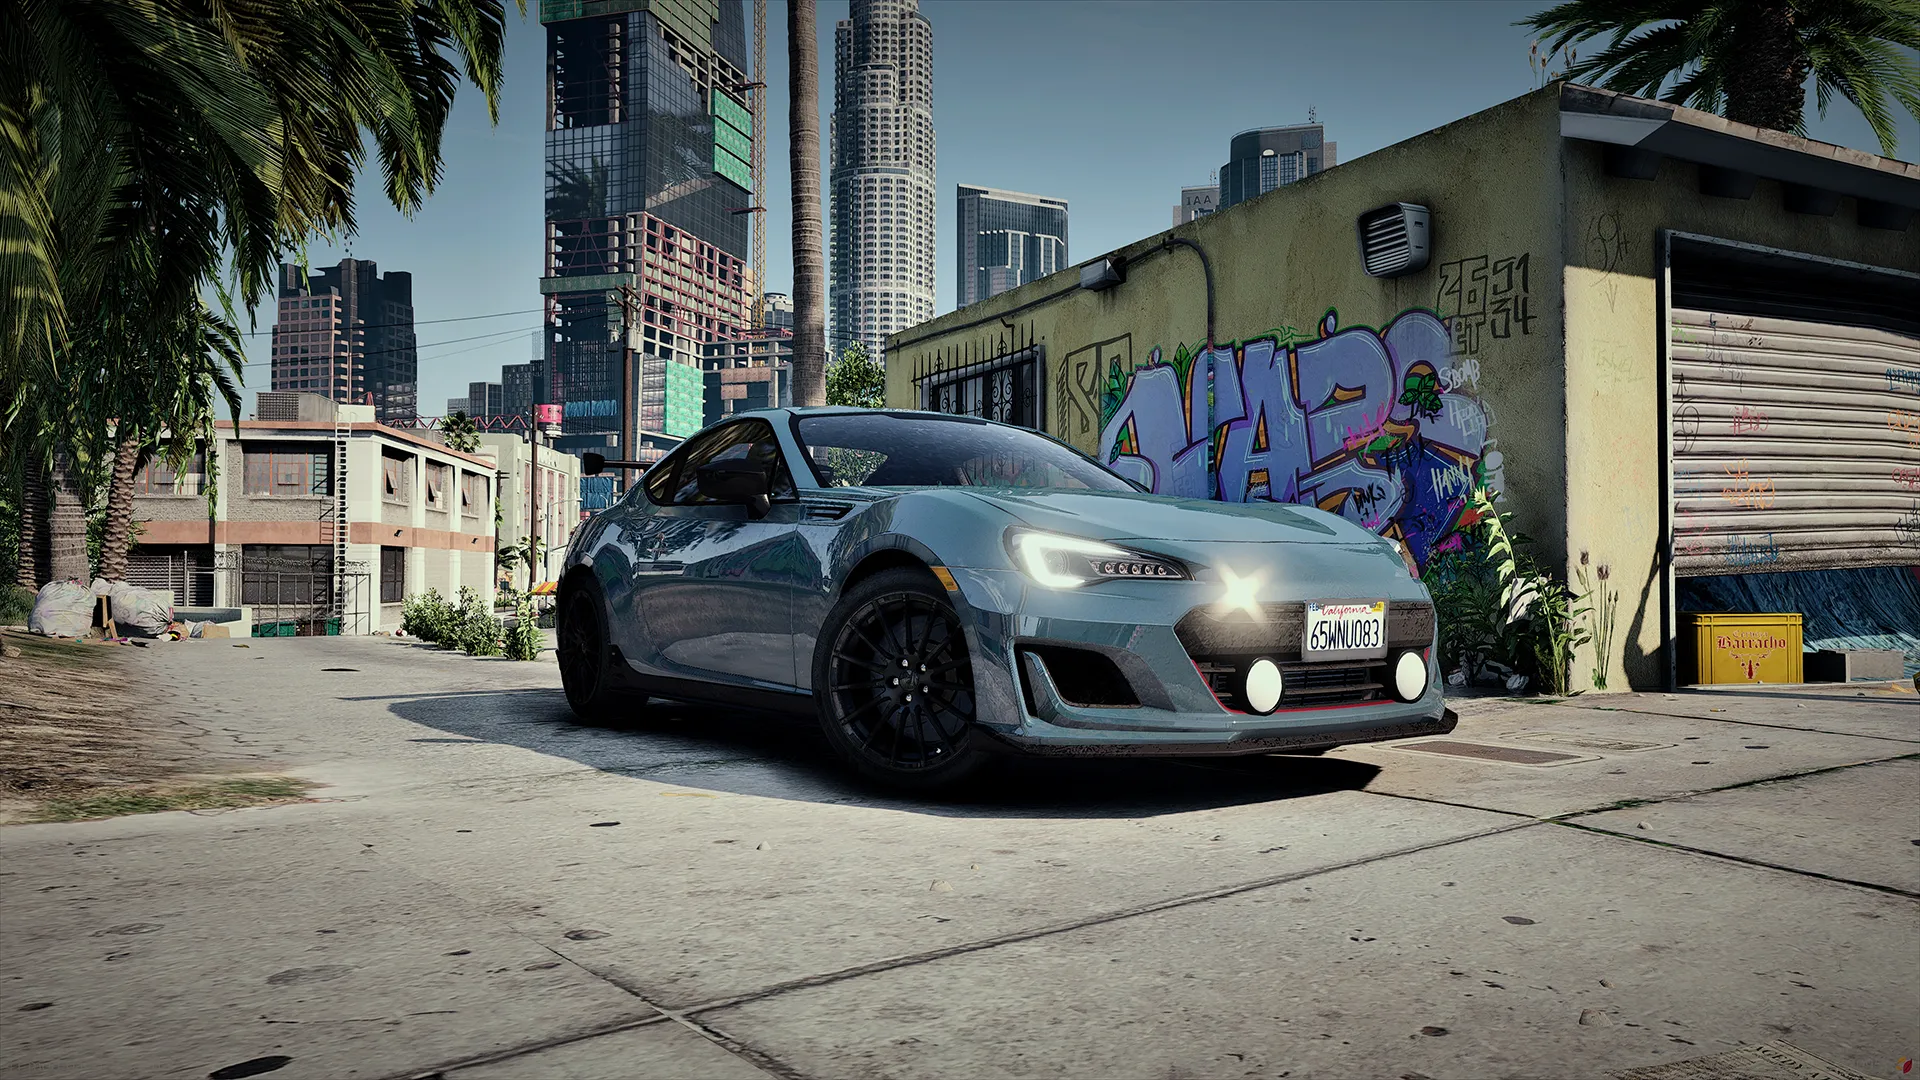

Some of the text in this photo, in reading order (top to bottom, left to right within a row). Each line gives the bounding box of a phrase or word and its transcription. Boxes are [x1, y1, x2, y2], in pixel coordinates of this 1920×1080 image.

[1186, 195, 1212, 206] IAA
[1321, 604, 1372, 619] California
[1310, 619, 1380, 650] 65WNU083
[1716, 635, 1787, 650] Barracho
